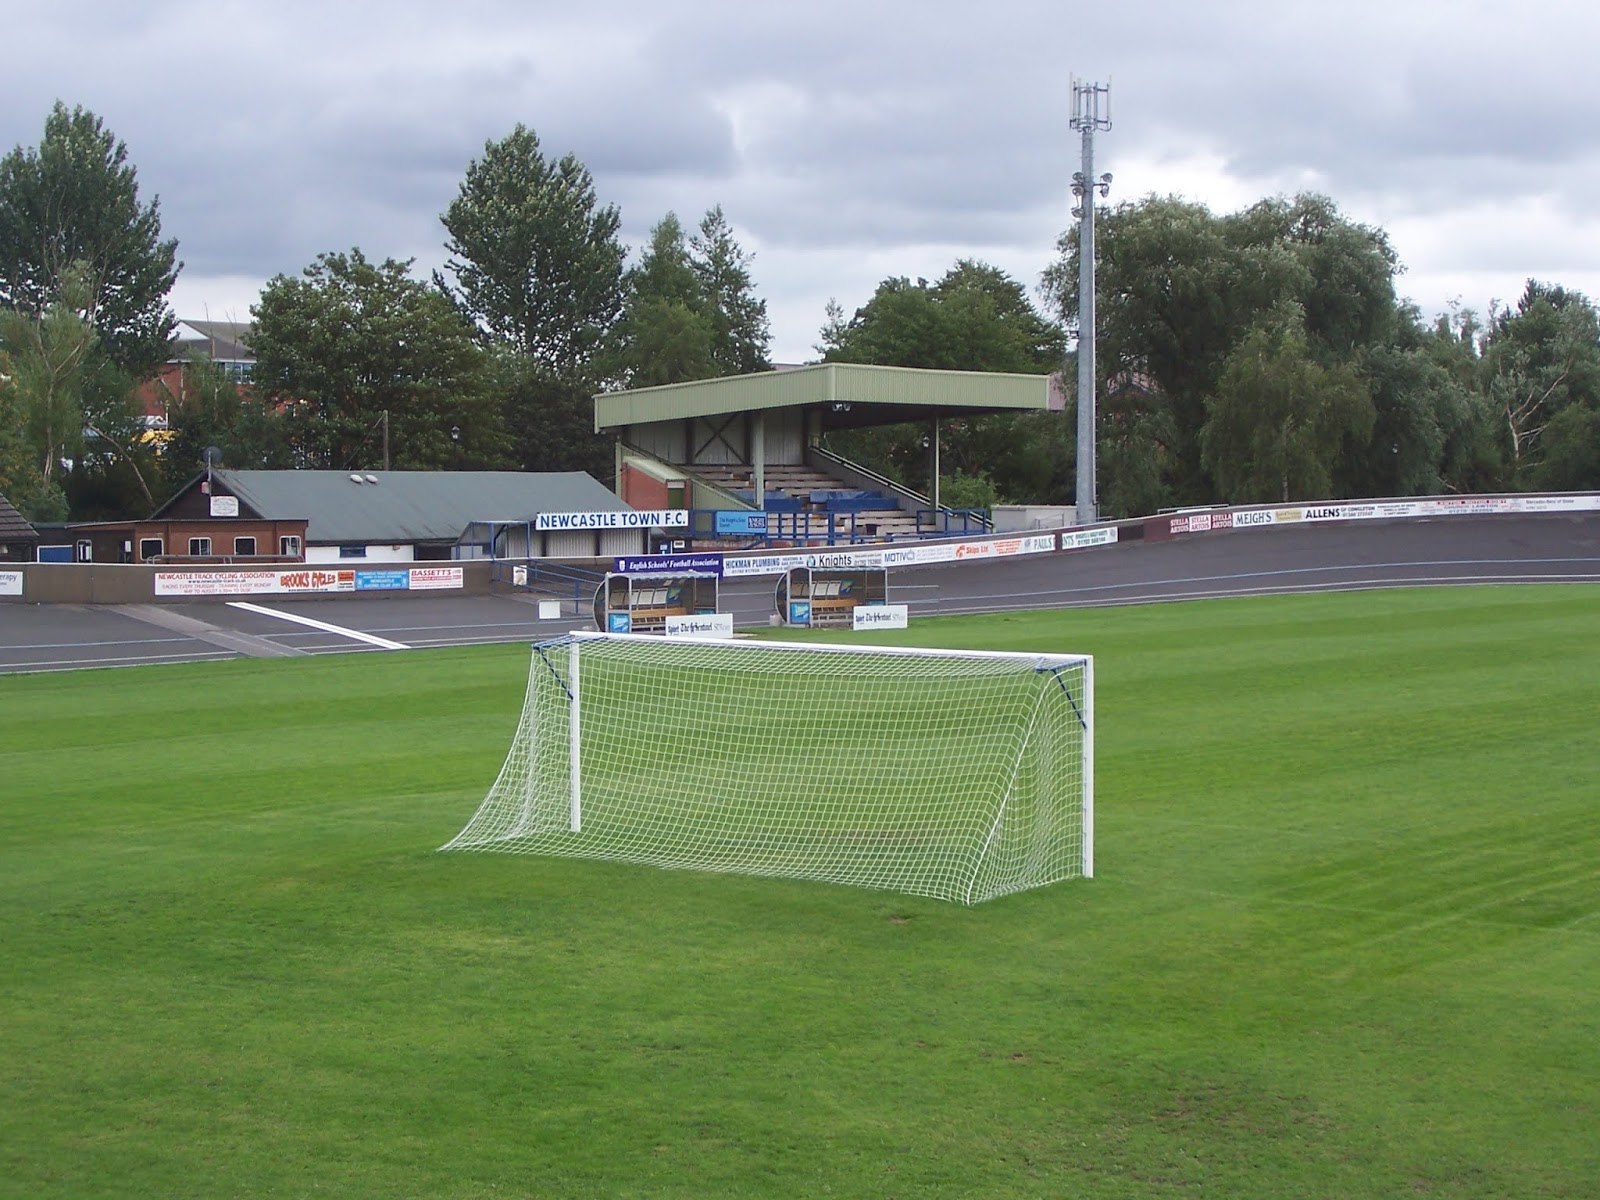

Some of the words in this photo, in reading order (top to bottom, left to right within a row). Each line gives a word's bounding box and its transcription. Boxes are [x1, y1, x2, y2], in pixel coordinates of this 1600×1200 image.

[1212, 514, 1232, 522] STELLA
[1306, 508, 1340, 518] ALLENS
[540, 514, 616, 528] NEWCASTLE
[622, 513, 660, 526] TOWN
[666, 512, 686, 524] F.C.
[1171, 518, 1188, 526] STELLA
[1212, 520, 1232, 528] ARTOIS
[1170, 525, 1189, 534] ARTOIS
[966, 546, 980, 554] Skips
[629, 561, 647, 570] English
[648, 560, 670, 569] Schools'
[670, 560, 690, 568] Football
[691, 558, 720, 567] Association
[726, 560, 751, 569] HICKMAN
[752, 558, 780, 568] PLUMBING
[820, 554, 852, 566] Knights
[281, 572, 310, 588] BROOKS
[312, 572, 336, 588] CYCLES
